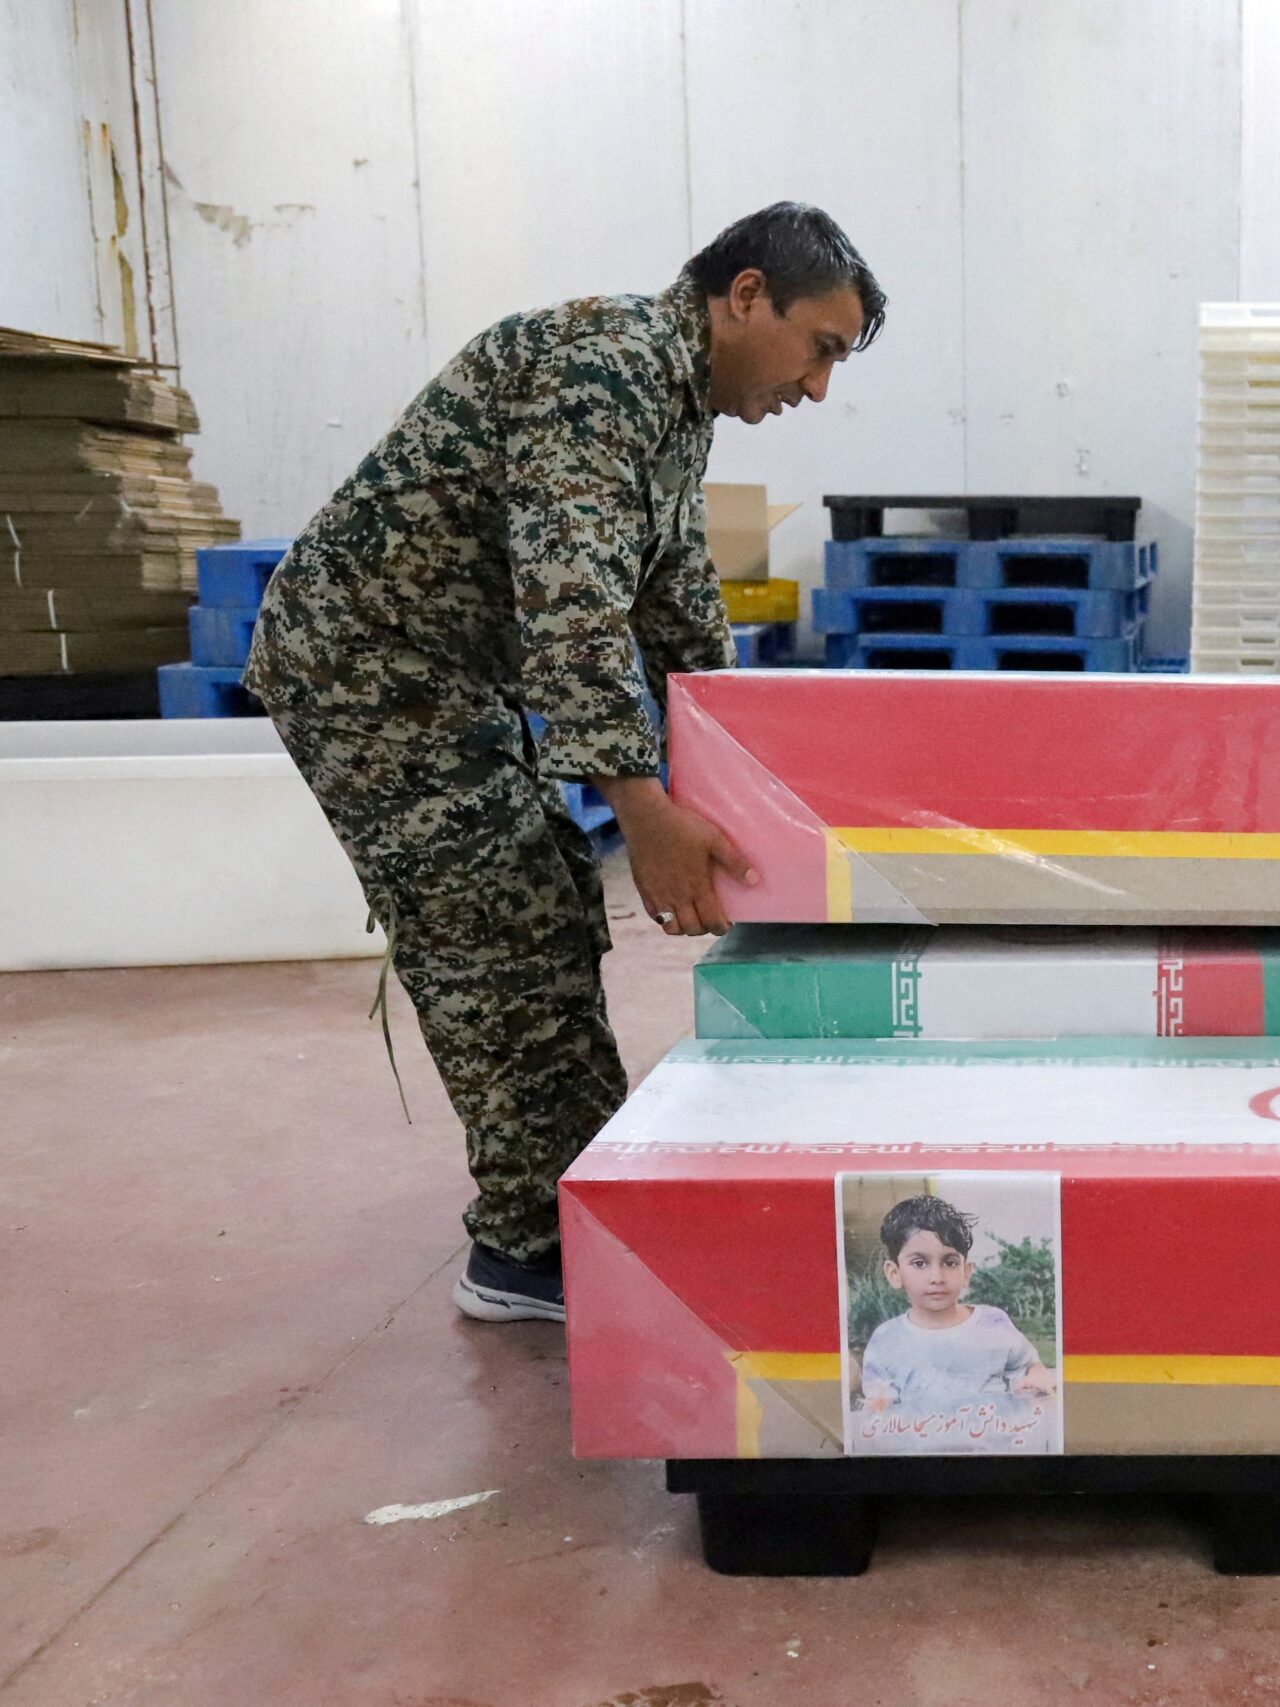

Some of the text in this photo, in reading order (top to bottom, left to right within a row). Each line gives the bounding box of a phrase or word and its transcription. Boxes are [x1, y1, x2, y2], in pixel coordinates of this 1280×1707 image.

[861, 1414, 911, 1438] سالاری
[969, 1404, 1007, 1439] دانش
[1010, 1406, 1043, 1445] شهید
